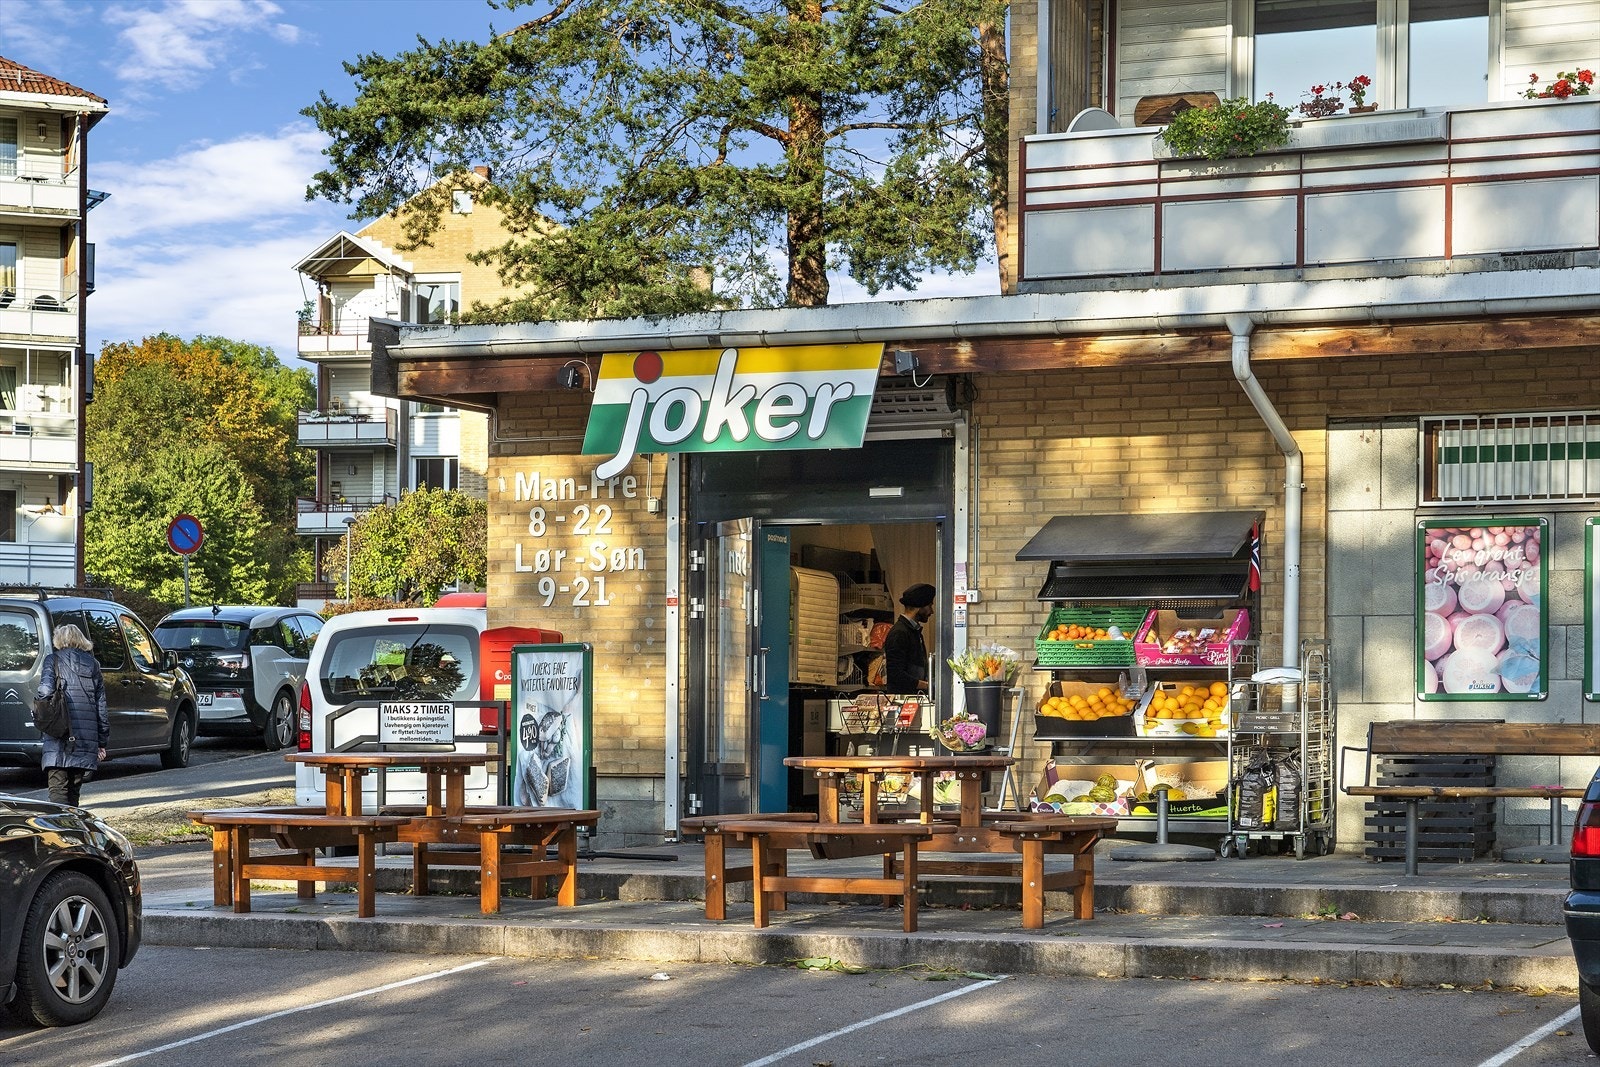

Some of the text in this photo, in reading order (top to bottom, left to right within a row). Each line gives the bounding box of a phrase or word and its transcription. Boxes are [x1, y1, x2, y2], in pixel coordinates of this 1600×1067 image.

[595, 348, 855, 480] joker
[1441, 542, 1526, 566] Lev grønt.
[1433, 564, 1468, 588] Spis
[383, 704, 450, 715] MAKS 2 TIMER
[1169, 804, 1203, 813] Huerta
